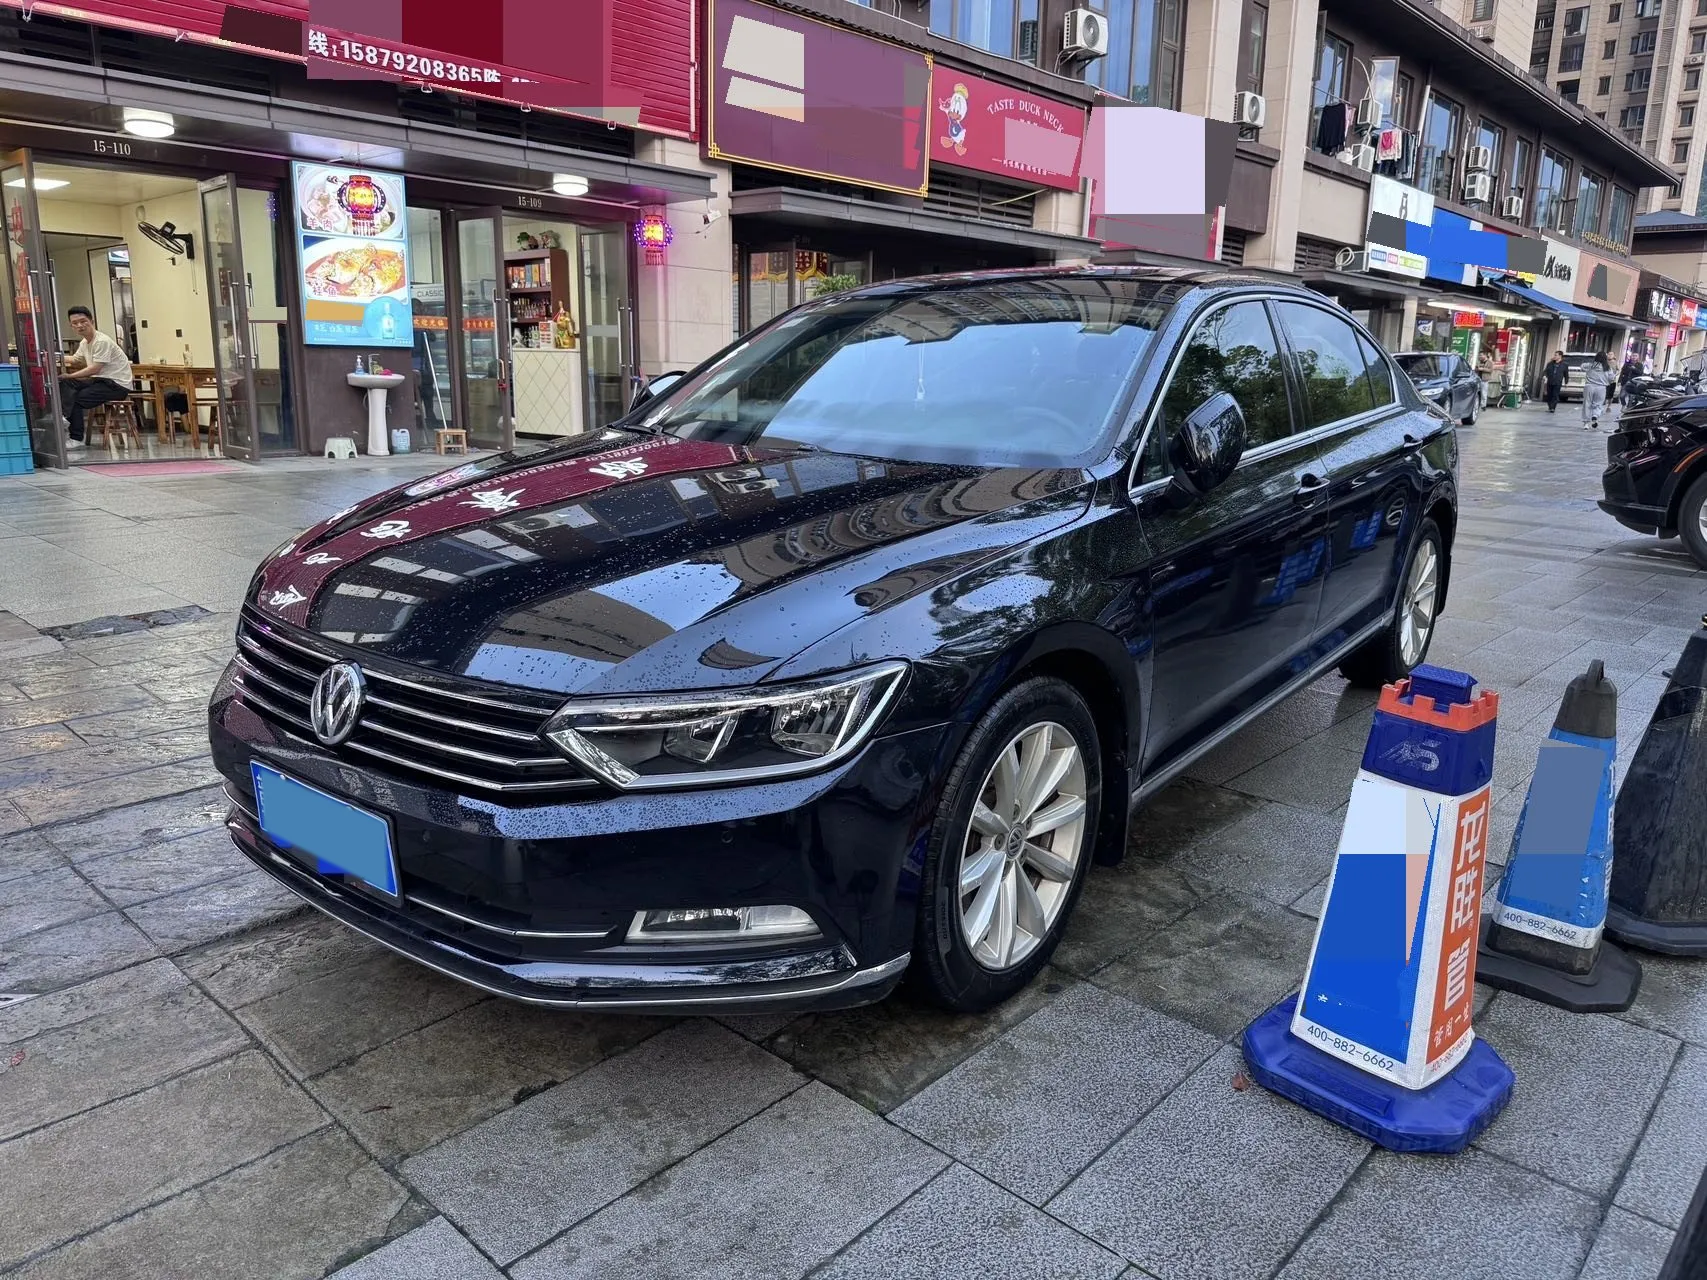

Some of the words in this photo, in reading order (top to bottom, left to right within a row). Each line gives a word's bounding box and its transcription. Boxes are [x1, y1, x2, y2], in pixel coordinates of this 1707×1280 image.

[987, 99, 1014, 115] TASTE
[1019, 100, 1040, 116] DUCK
[1043, 109, 1064, 133] NECK
[93, 140, 131, 155] 15-110
[518, 196, 542, 208] 15-109
[1504, 912, 1577, 941] 400-882-6662
[1433, 1001, 1470, 1049] 管用一生
[1307, 1025, 1394, 1073] 400-882-6662
